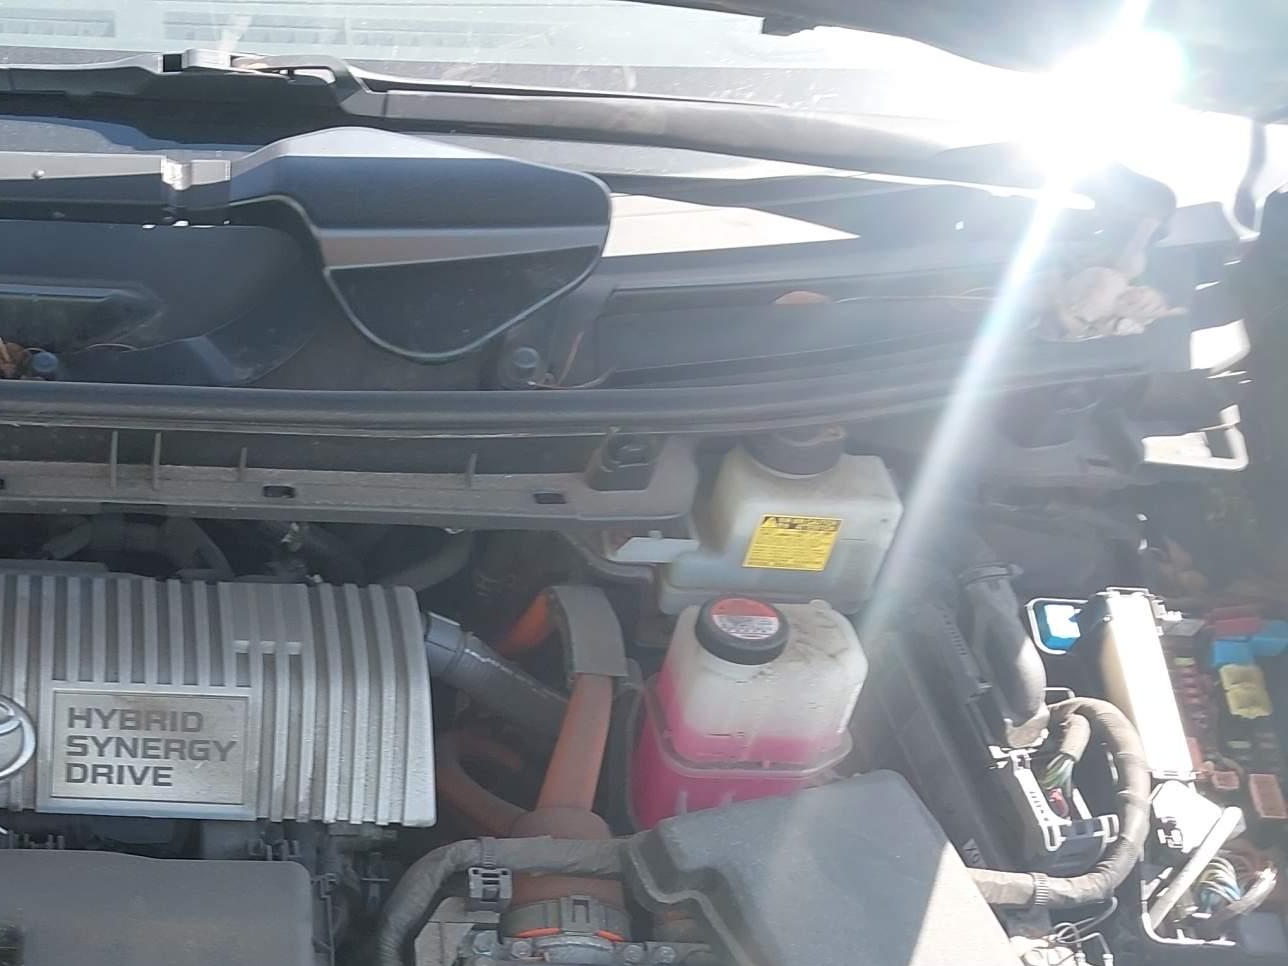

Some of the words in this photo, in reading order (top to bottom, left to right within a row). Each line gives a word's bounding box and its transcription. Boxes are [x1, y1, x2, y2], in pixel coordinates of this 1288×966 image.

[67, 707, 204, 732] HYBRID
[66, 735, 237, 762] SYNERGY
[65, 762, 174, 787] DRIVE
